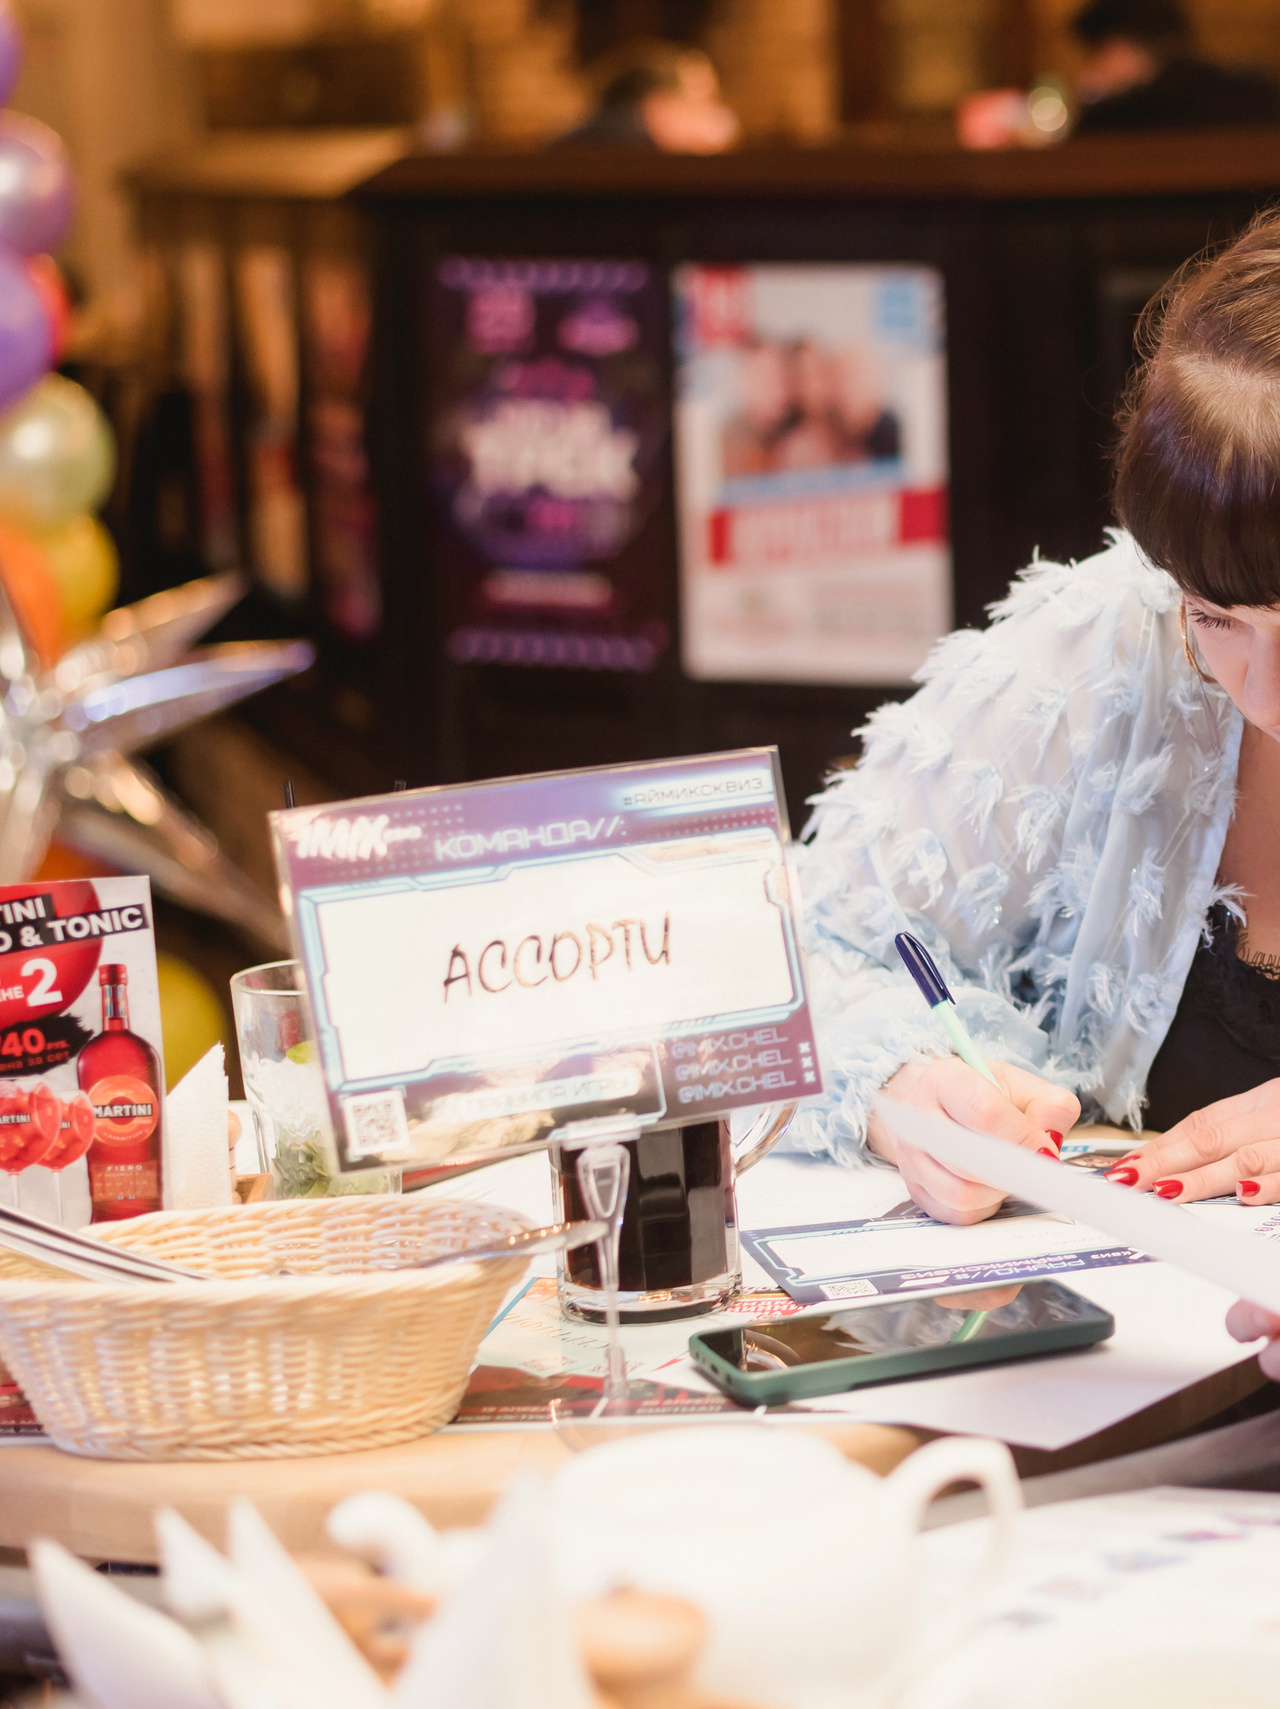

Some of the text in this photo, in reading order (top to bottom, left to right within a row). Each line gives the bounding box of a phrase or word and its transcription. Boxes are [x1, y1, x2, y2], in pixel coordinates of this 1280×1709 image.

[0, 896, 46, 925] INI
[20, 925, 44, 948] &
[46, 907, 143, 942] TONIC
[442, 910, 672, 1004] АССОРТИ
[21, 957, 64, 1007] 2
[0, 1028, 46, 1057] 40
